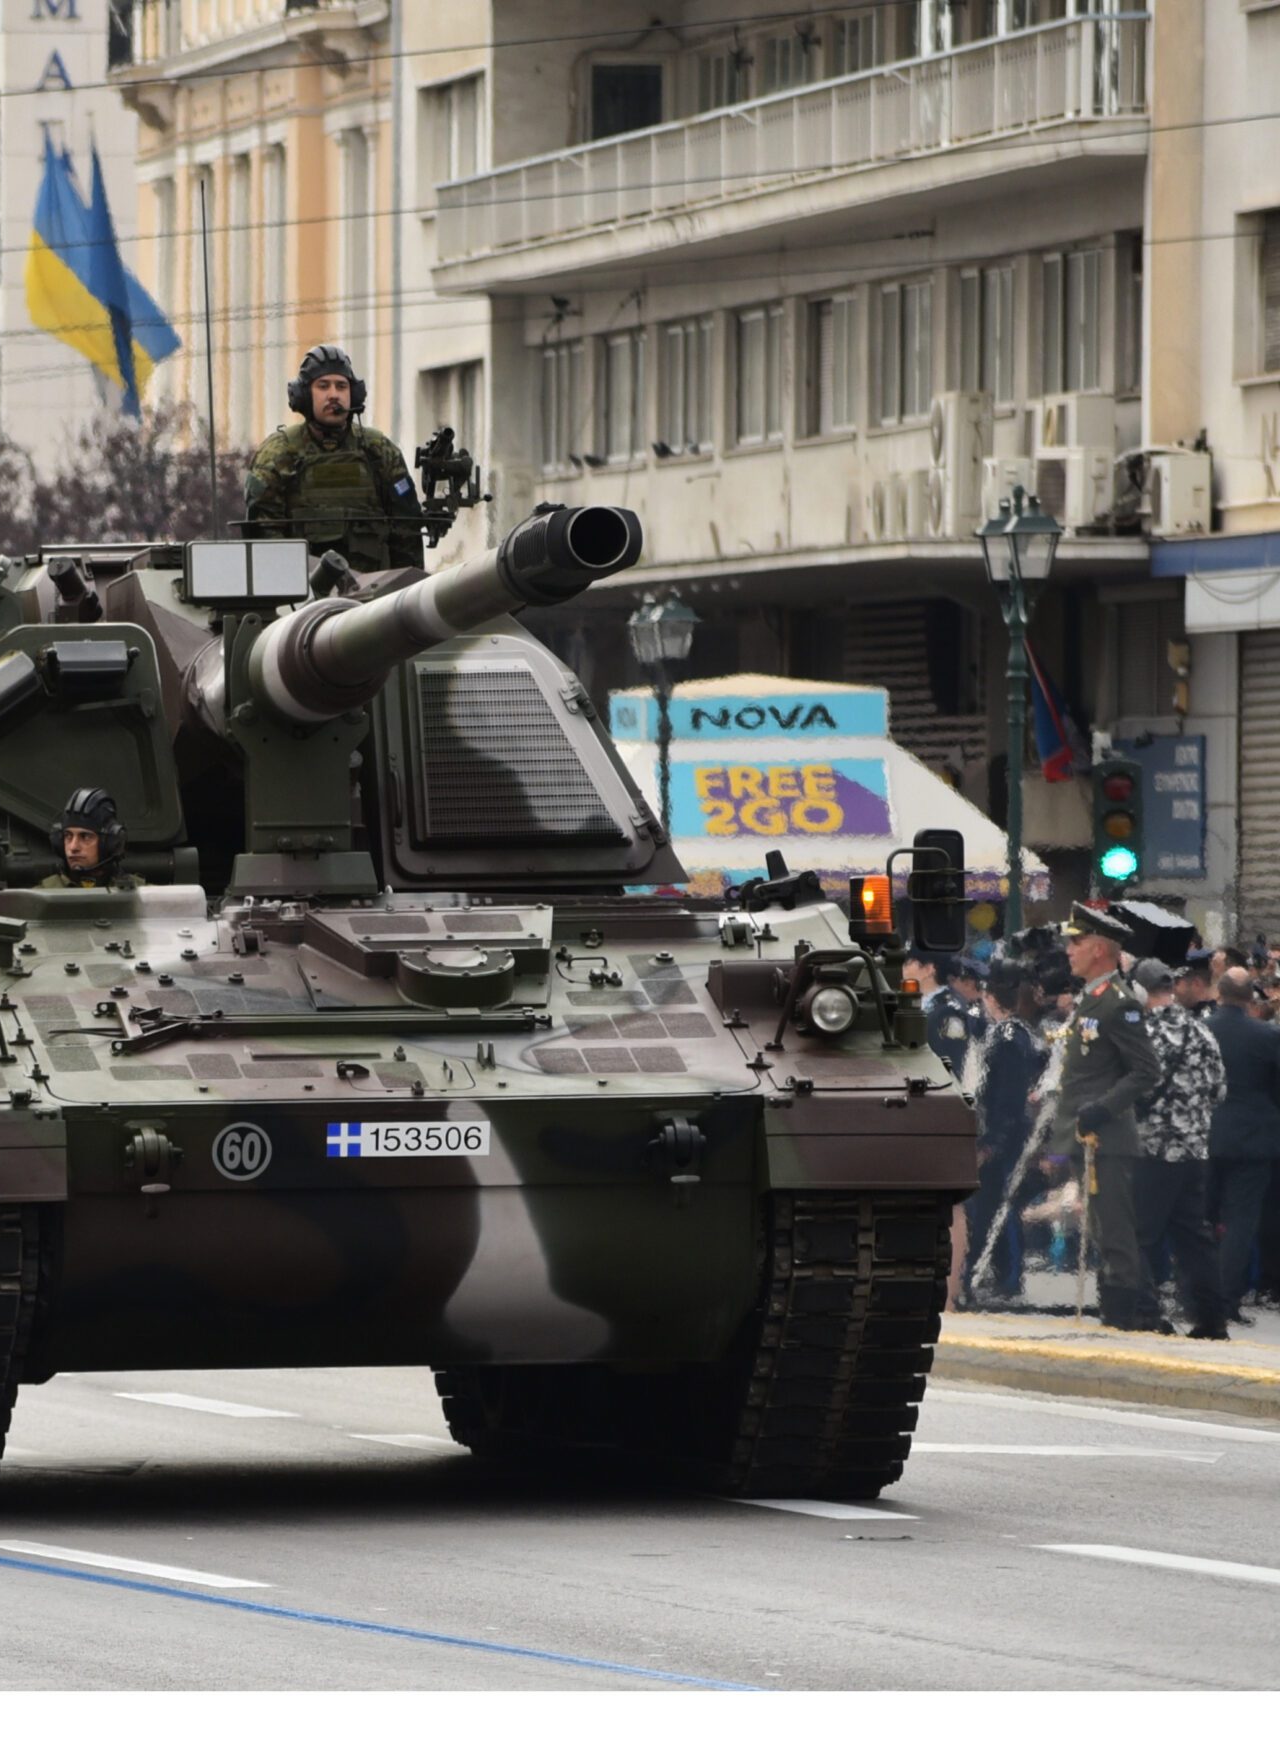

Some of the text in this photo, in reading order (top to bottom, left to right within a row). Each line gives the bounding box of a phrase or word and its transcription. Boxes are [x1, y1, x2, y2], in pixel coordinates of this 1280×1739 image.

[690, 703, 837, 731] NOVA
[694, 764, 837, 801] FREE
[700, 799, 844, 836] 2GO
[222, 1131, 262, 1170] 60
[370, 1126, 482, 1152] 153506
